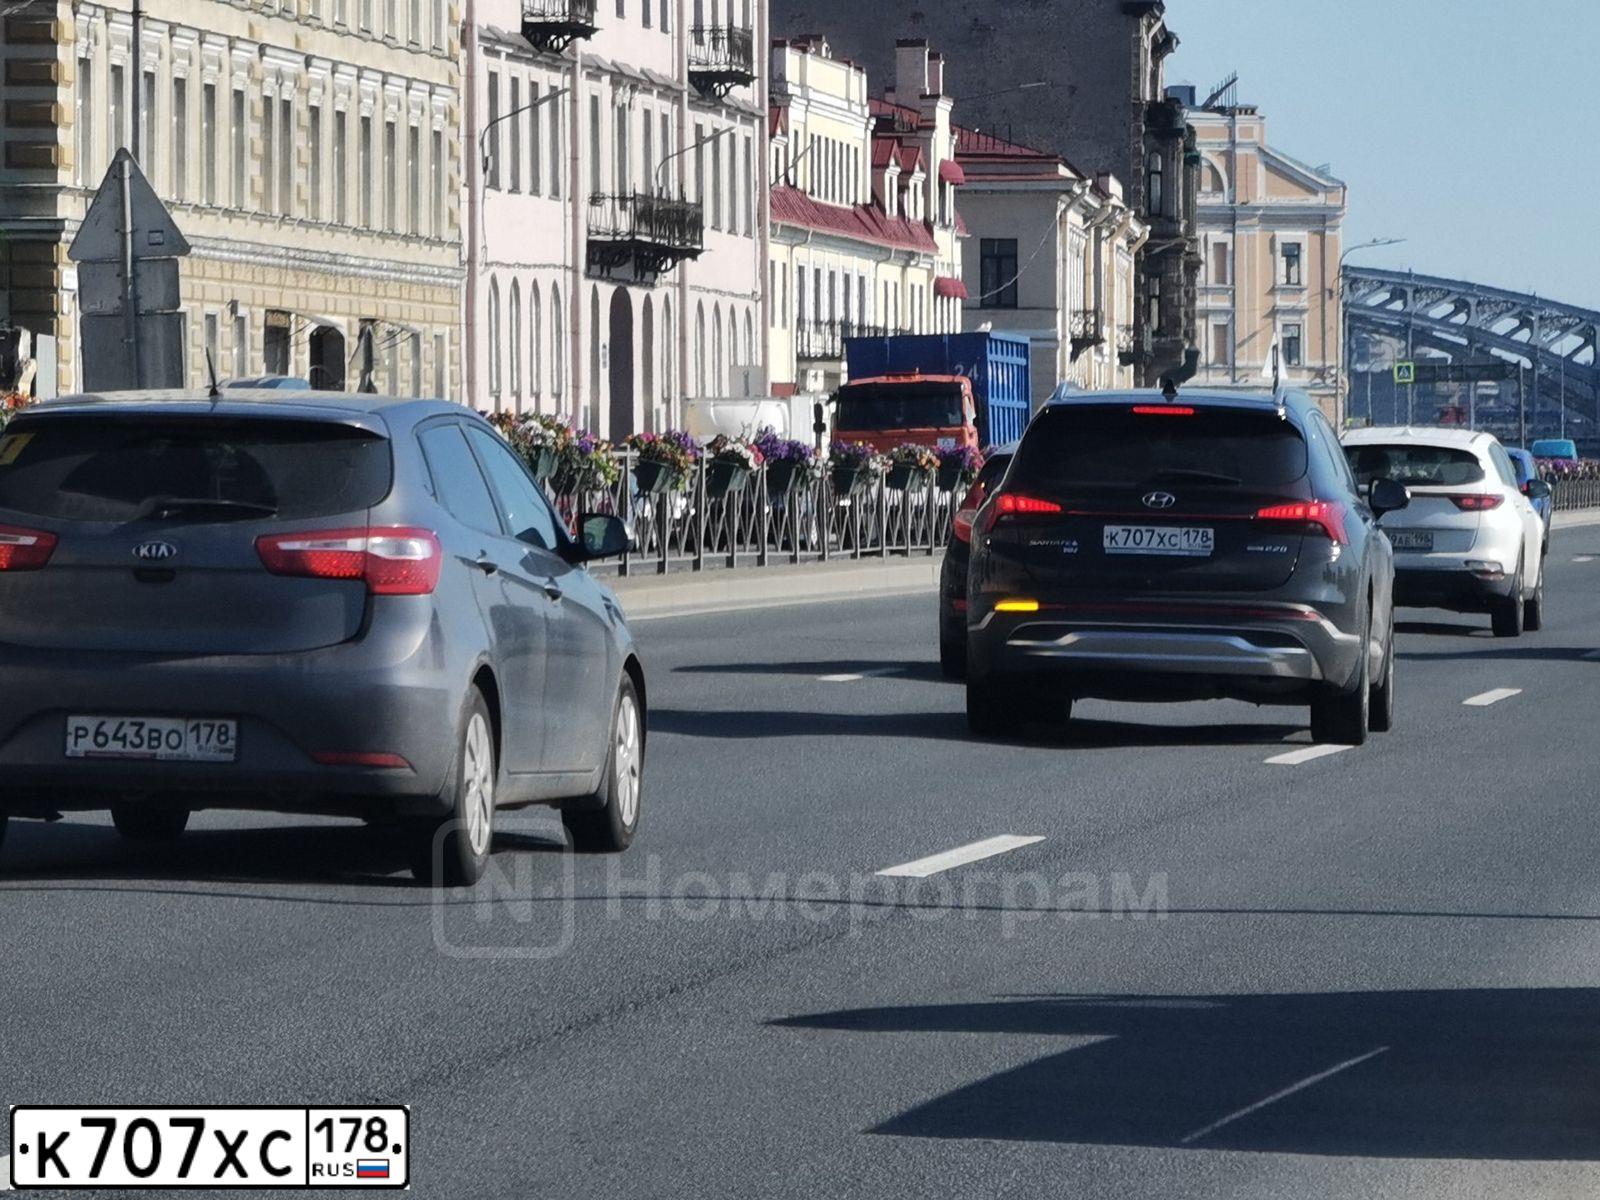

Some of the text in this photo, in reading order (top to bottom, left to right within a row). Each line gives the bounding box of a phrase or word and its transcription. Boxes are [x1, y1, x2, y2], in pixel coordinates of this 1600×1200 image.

[1183, 529, 1209, 544] 178
[139, 544, 169, 558] KIA
[189, 723, 230, 745] 178
